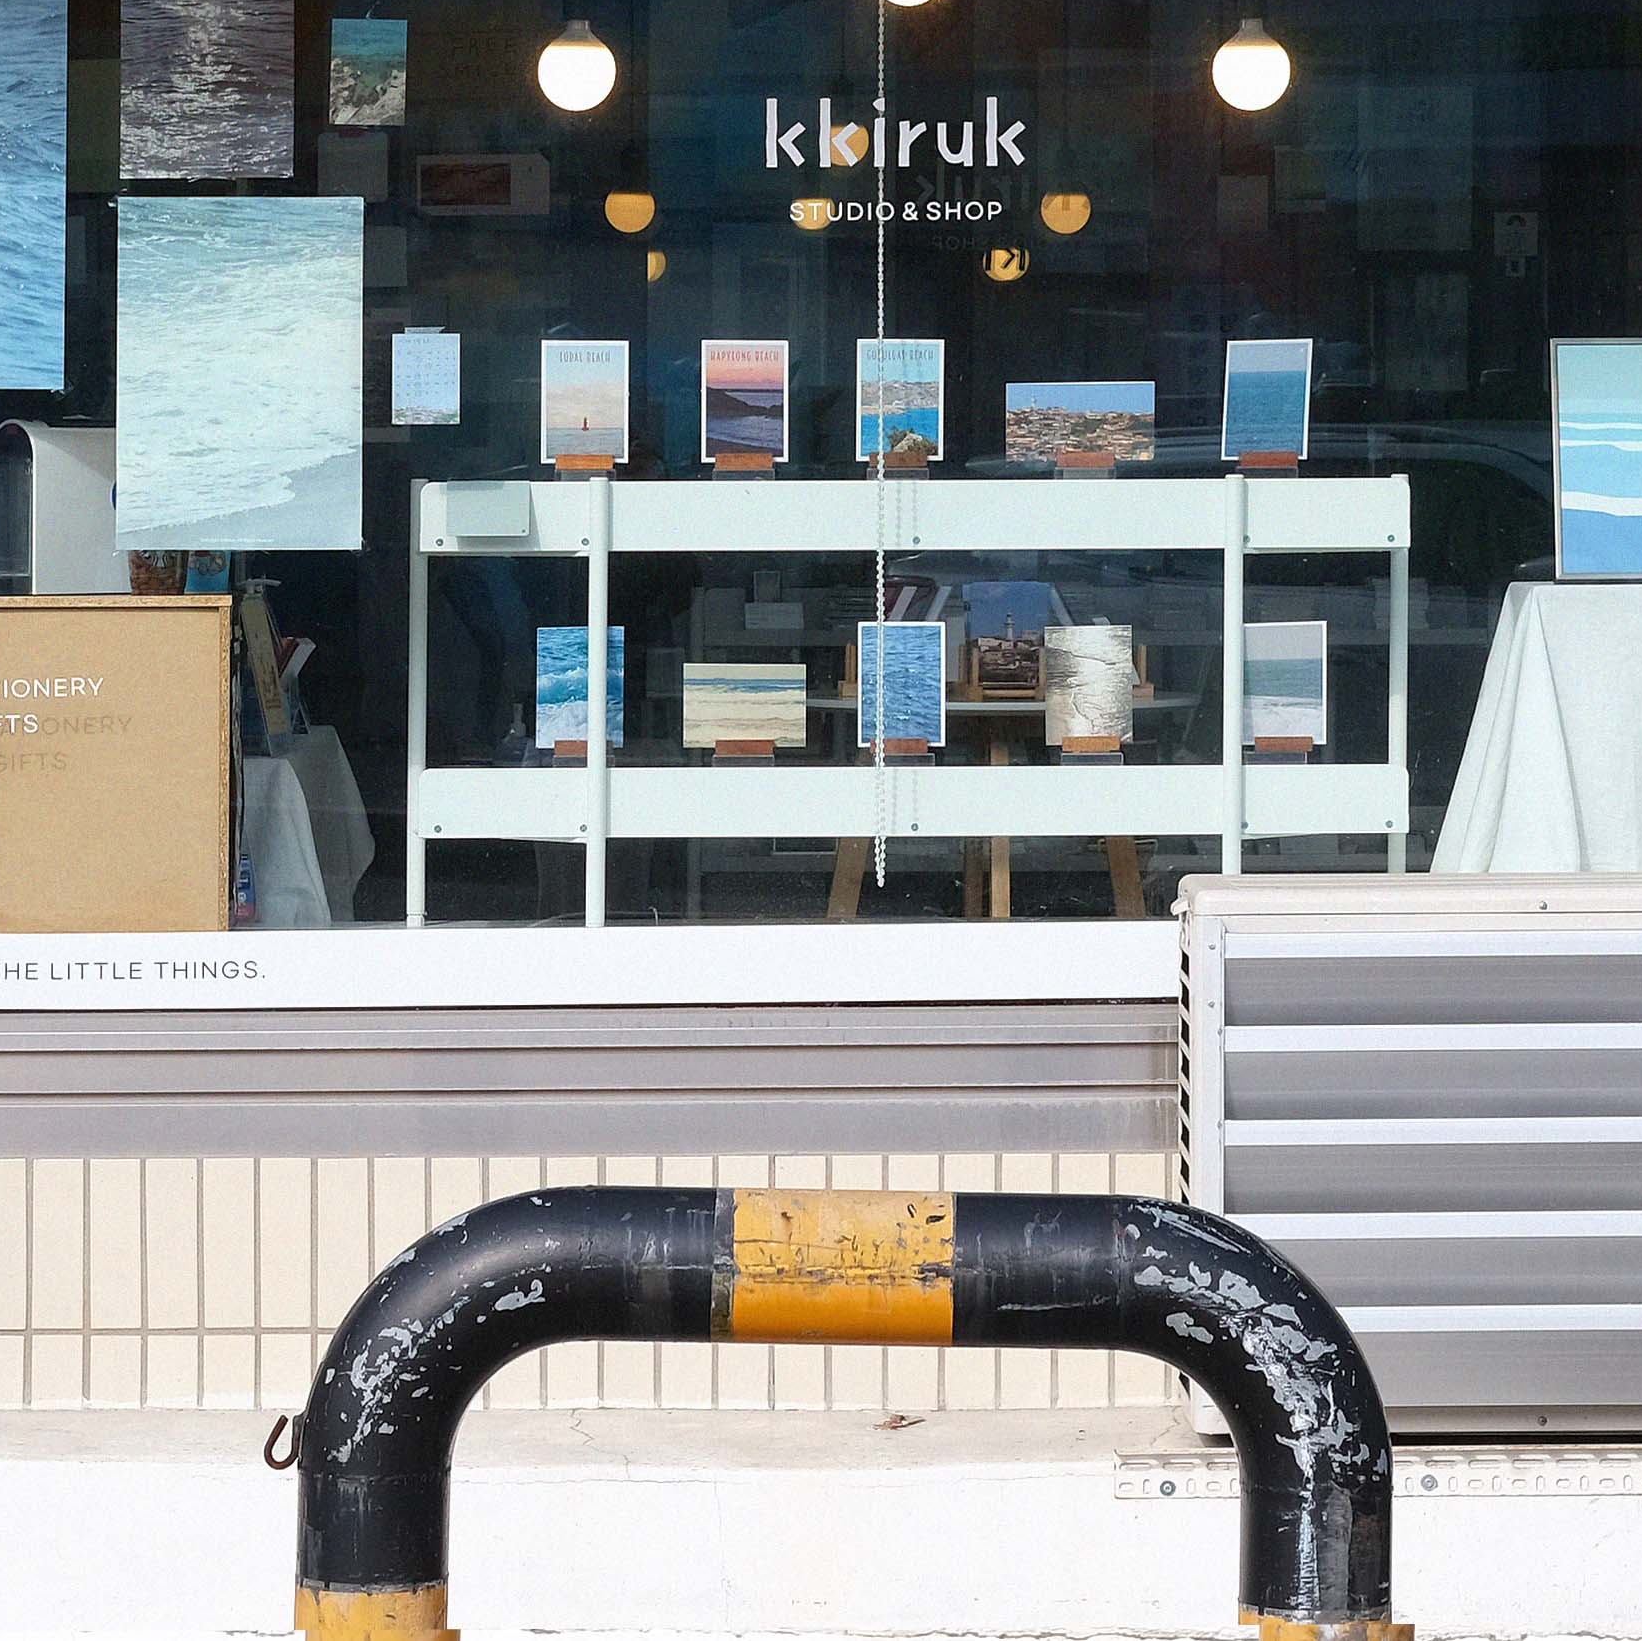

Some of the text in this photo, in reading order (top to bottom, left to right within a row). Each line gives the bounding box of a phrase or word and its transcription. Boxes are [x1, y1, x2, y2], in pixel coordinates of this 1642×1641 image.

[764, 96, 1027, 168] kkiruk
[789, 201, 1003, 222] STUDIO & SHOP
[755, 349, 779, 362] BEACH
[50, 962, 143, 981] LITTLE
[154, 961, 266, 980] THINGS.
